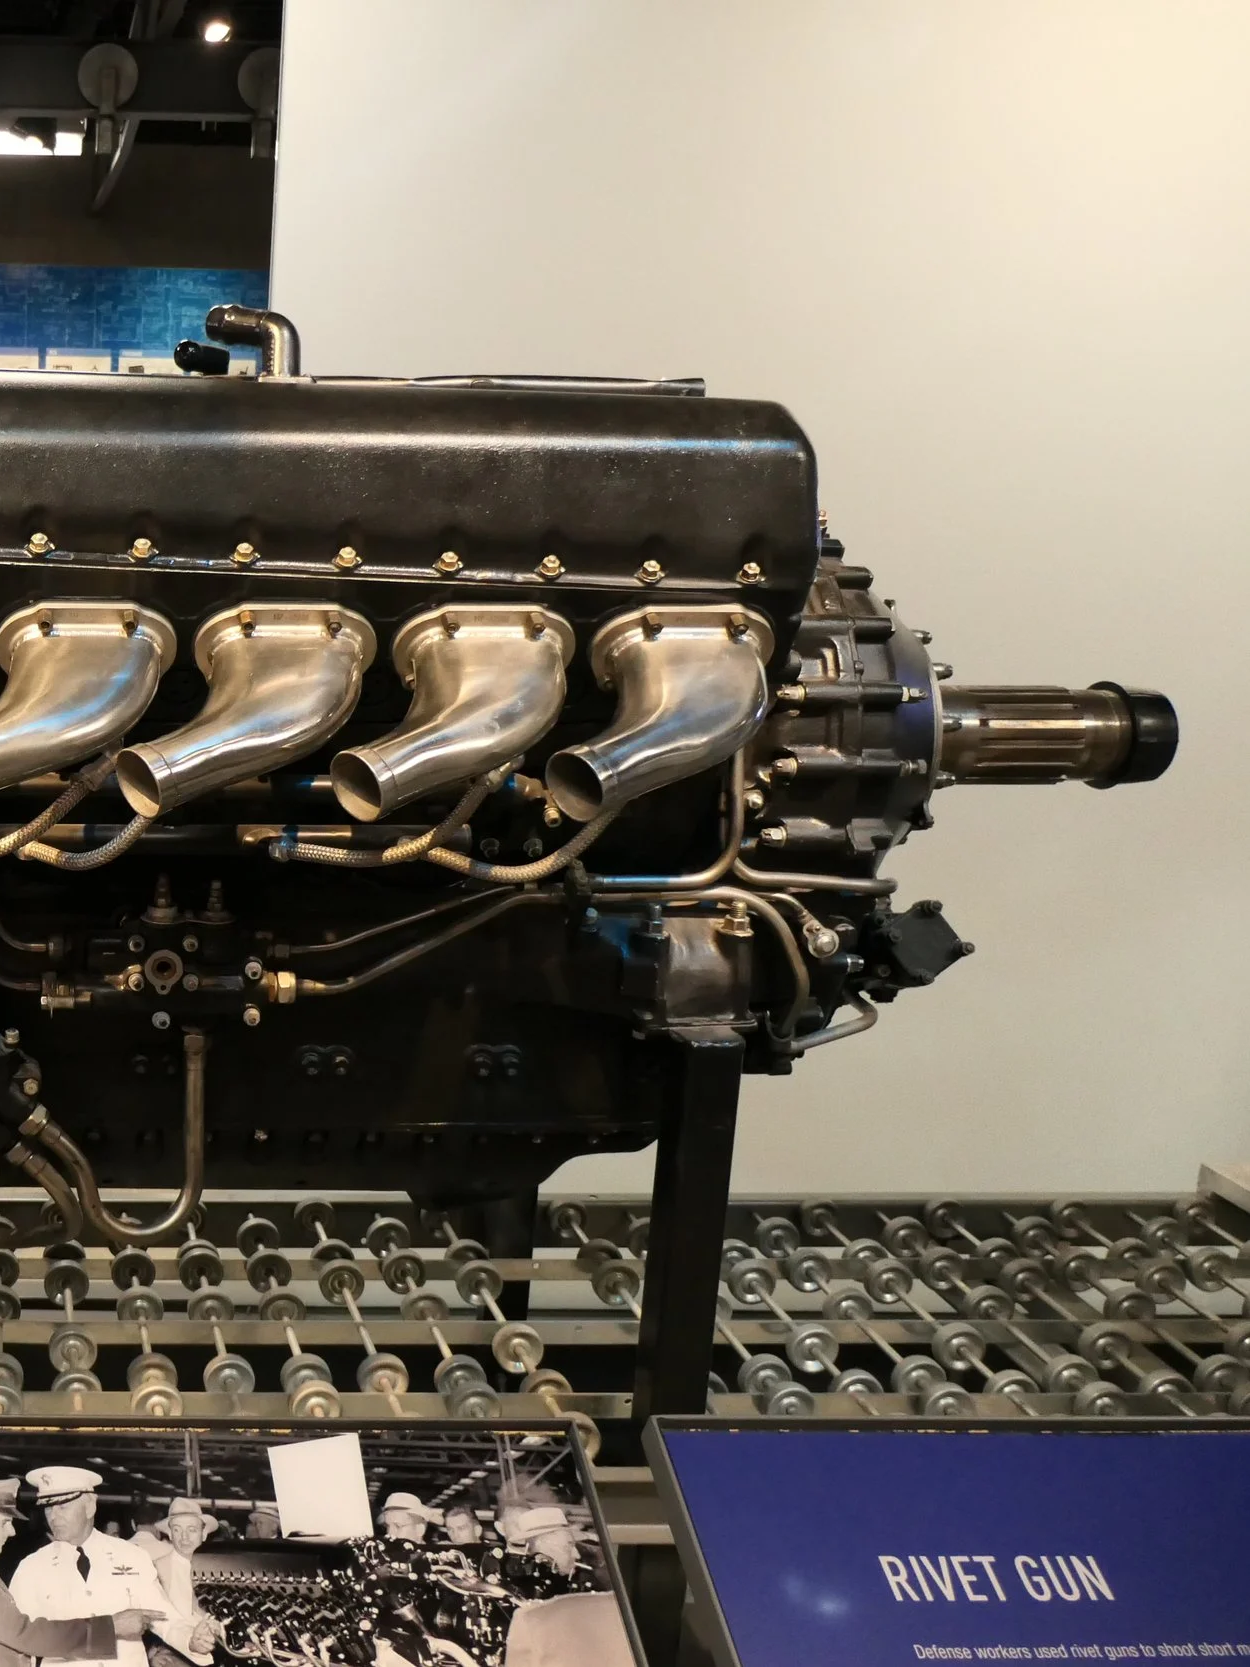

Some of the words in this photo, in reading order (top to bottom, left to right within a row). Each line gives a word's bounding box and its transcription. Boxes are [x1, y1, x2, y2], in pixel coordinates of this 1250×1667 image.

[878, 1555, 1007, 1602] RIVET
[1014, 1555, 1115, 1602] GUN
[912, 1643, 973, 1660] Defense
[973, 1643, 1032, 1660] workers
[1033, 1643, 1069, 1659] used
[1069, 1643, 1103, 1658] rivet
[1103, 1645, 1140, 1661] guns
[1139, 1643, 1156, 1658] to
[1157, 1642, 1198, 1657] shoot
[1197, 1641, 1238, 1657] short
